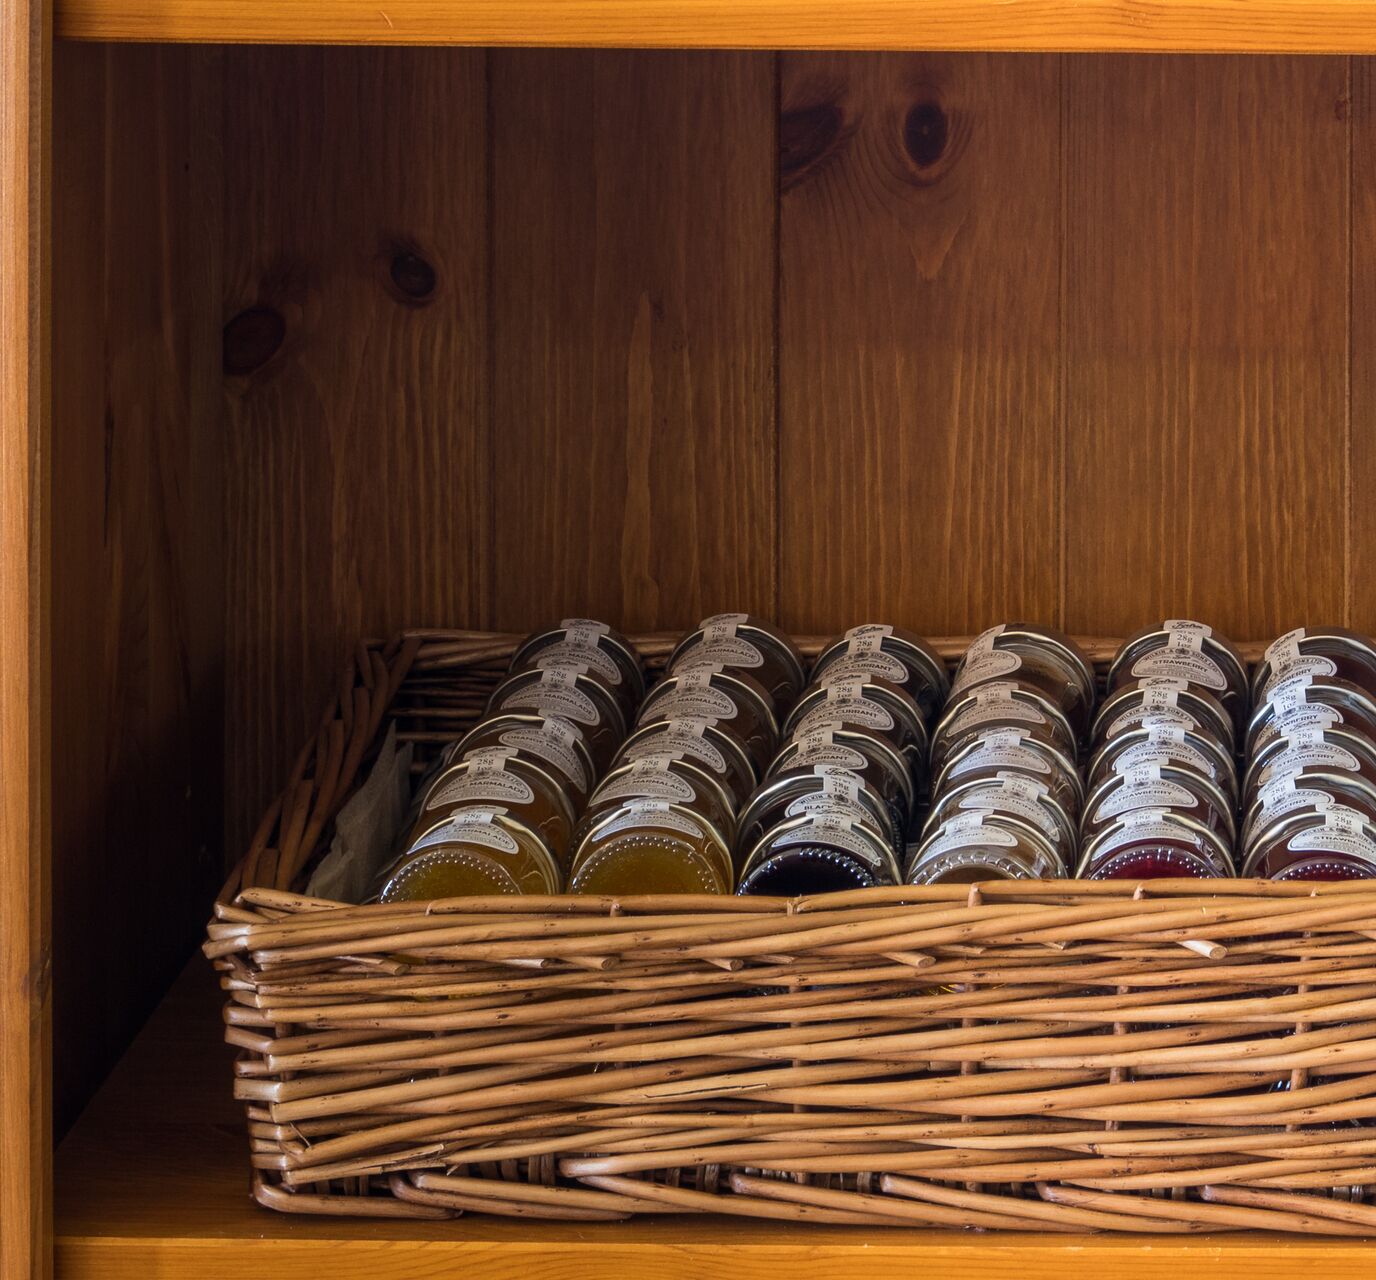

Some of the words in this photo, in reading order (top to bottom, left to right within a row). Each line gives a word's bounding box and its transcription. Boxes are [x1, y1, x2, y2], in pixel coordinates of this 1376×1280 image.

[1177, 634, 1194, 643] 28g
[1151, 690, 1168, 700] 28g
[1157, 729, 1174, 737] 28g
[1335, 815, 1353, 826] 28g
